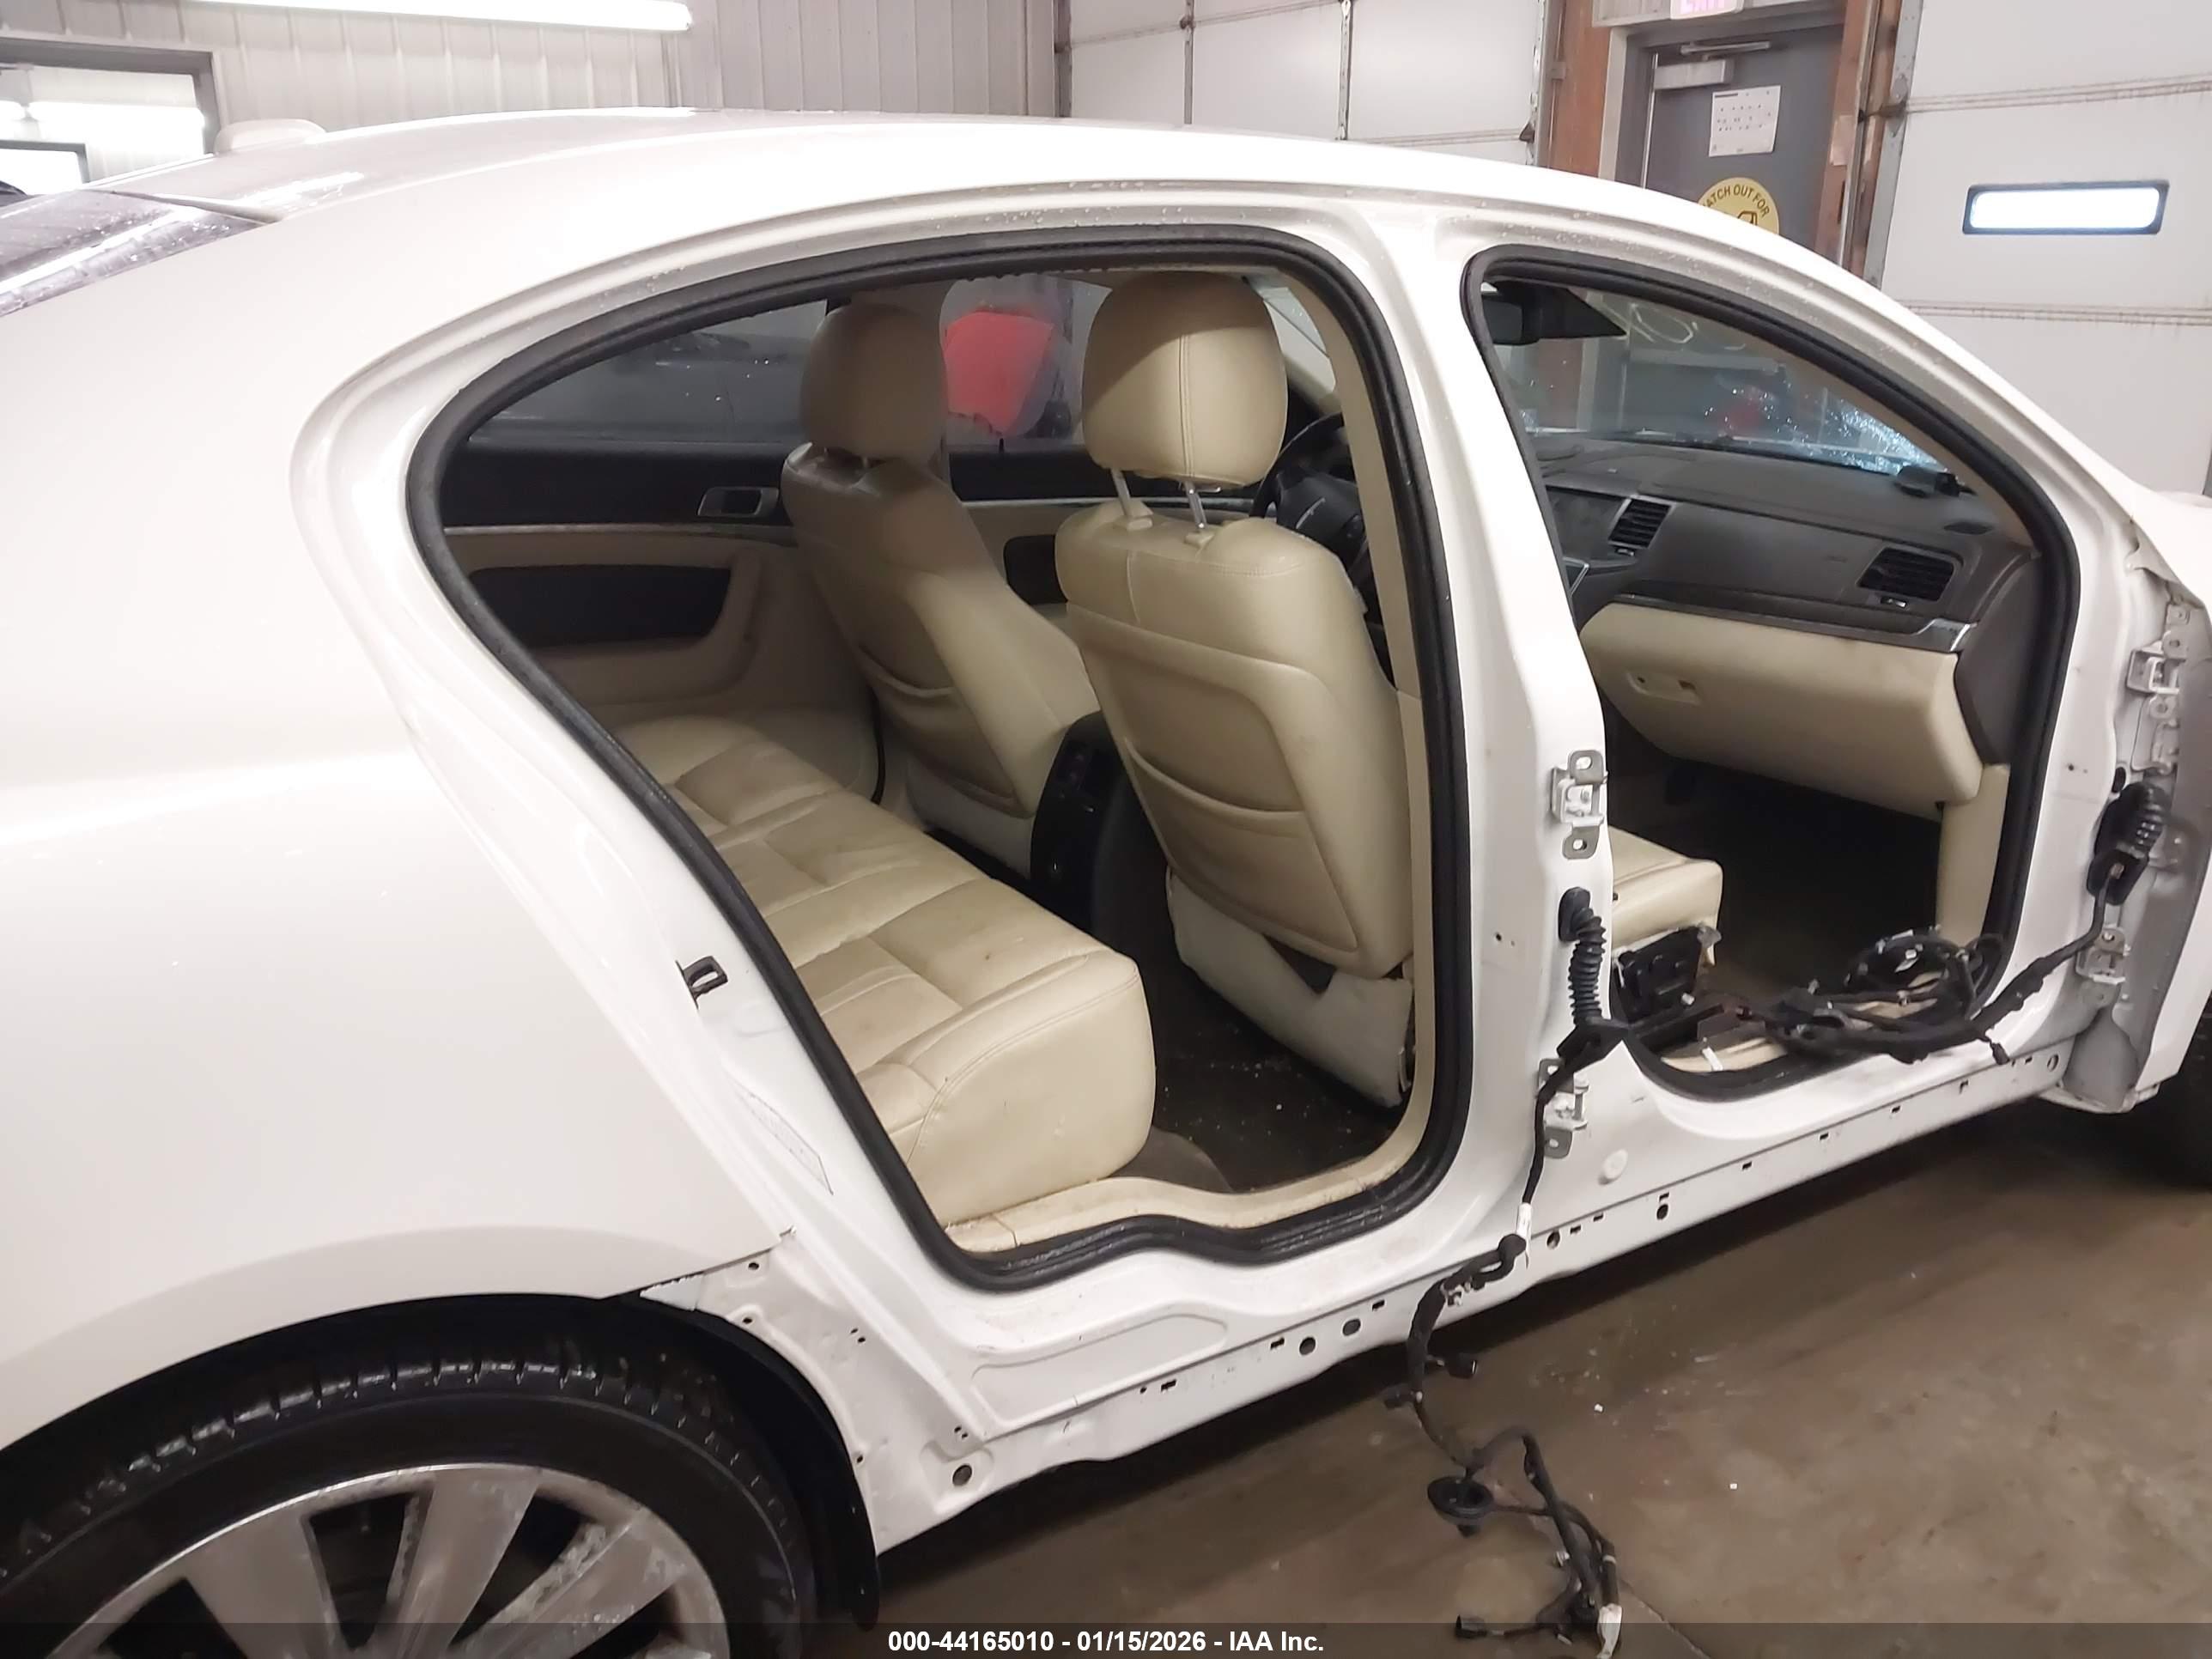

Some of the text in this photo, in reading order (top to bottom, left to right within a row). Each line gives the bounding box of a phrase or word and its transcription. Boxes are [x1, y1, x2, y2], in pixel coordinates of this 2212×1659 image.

[1704, 184, 1771, 218] ATCH OUT FOR
